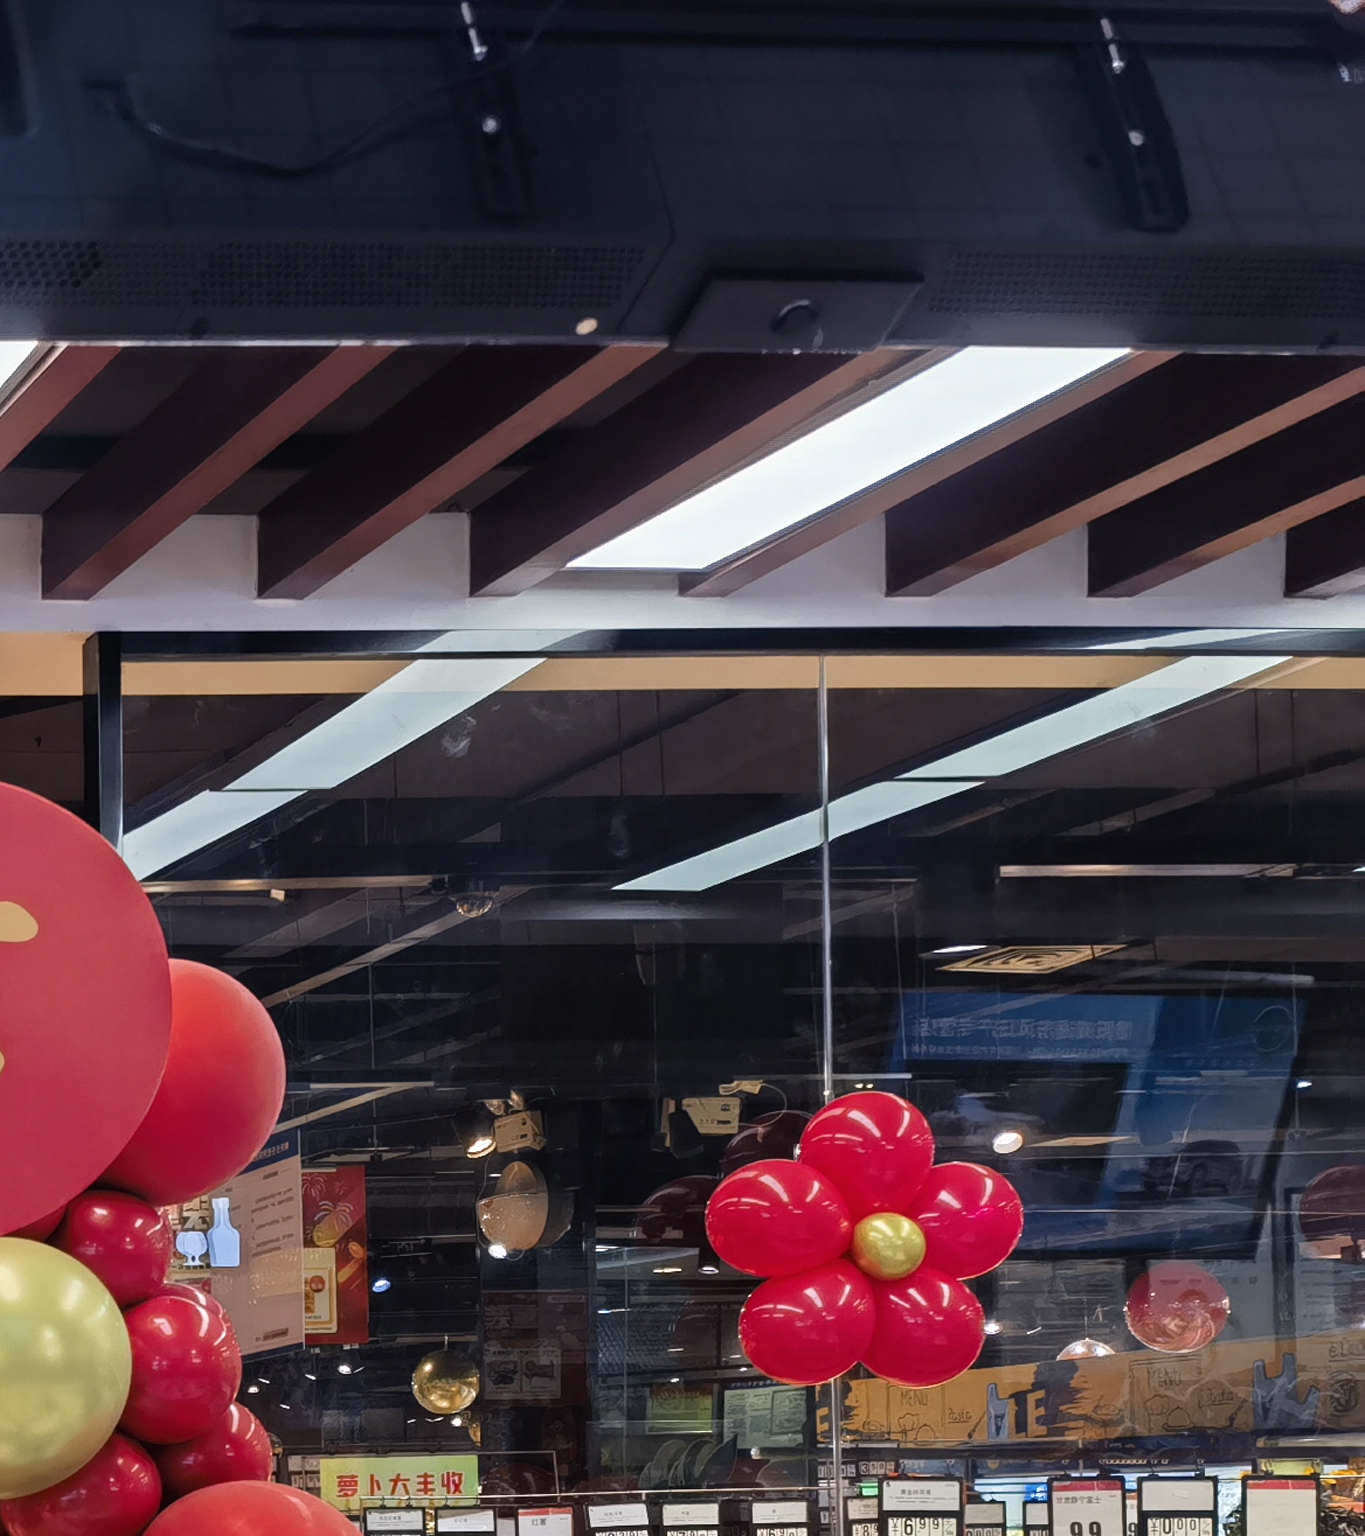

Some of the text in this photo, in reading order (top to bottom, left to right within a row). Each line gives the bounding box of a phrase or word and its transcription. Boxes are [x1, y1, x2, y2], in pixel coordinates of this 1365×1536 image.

[336, 1471, 465, 1498] 萝卜大丰收
